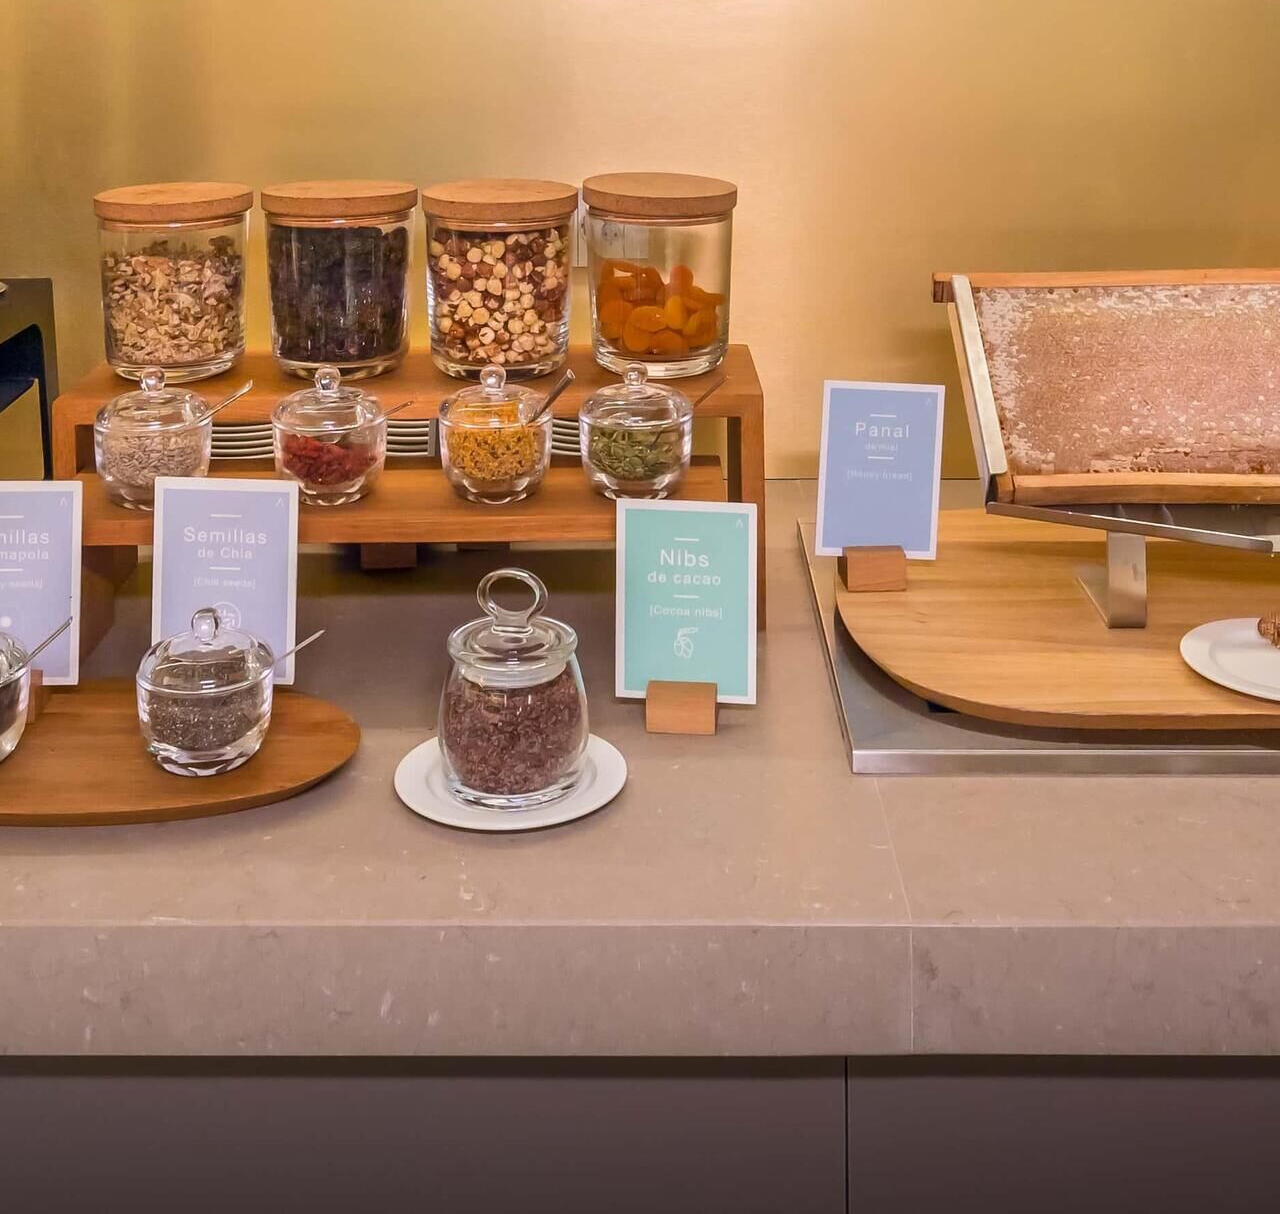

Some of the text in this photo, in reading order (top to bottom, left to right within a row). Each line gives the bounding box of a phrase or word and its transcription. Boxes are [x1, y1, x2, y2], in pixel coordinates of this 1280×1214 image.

[855, 421, 910, 438] Panal
[183, 526, 268, 545] Semillas
[197, 547, 253, 559] de Chia
[660, 548, 711, 568] Nibs
[647, 570, 722, 587] de cacao
